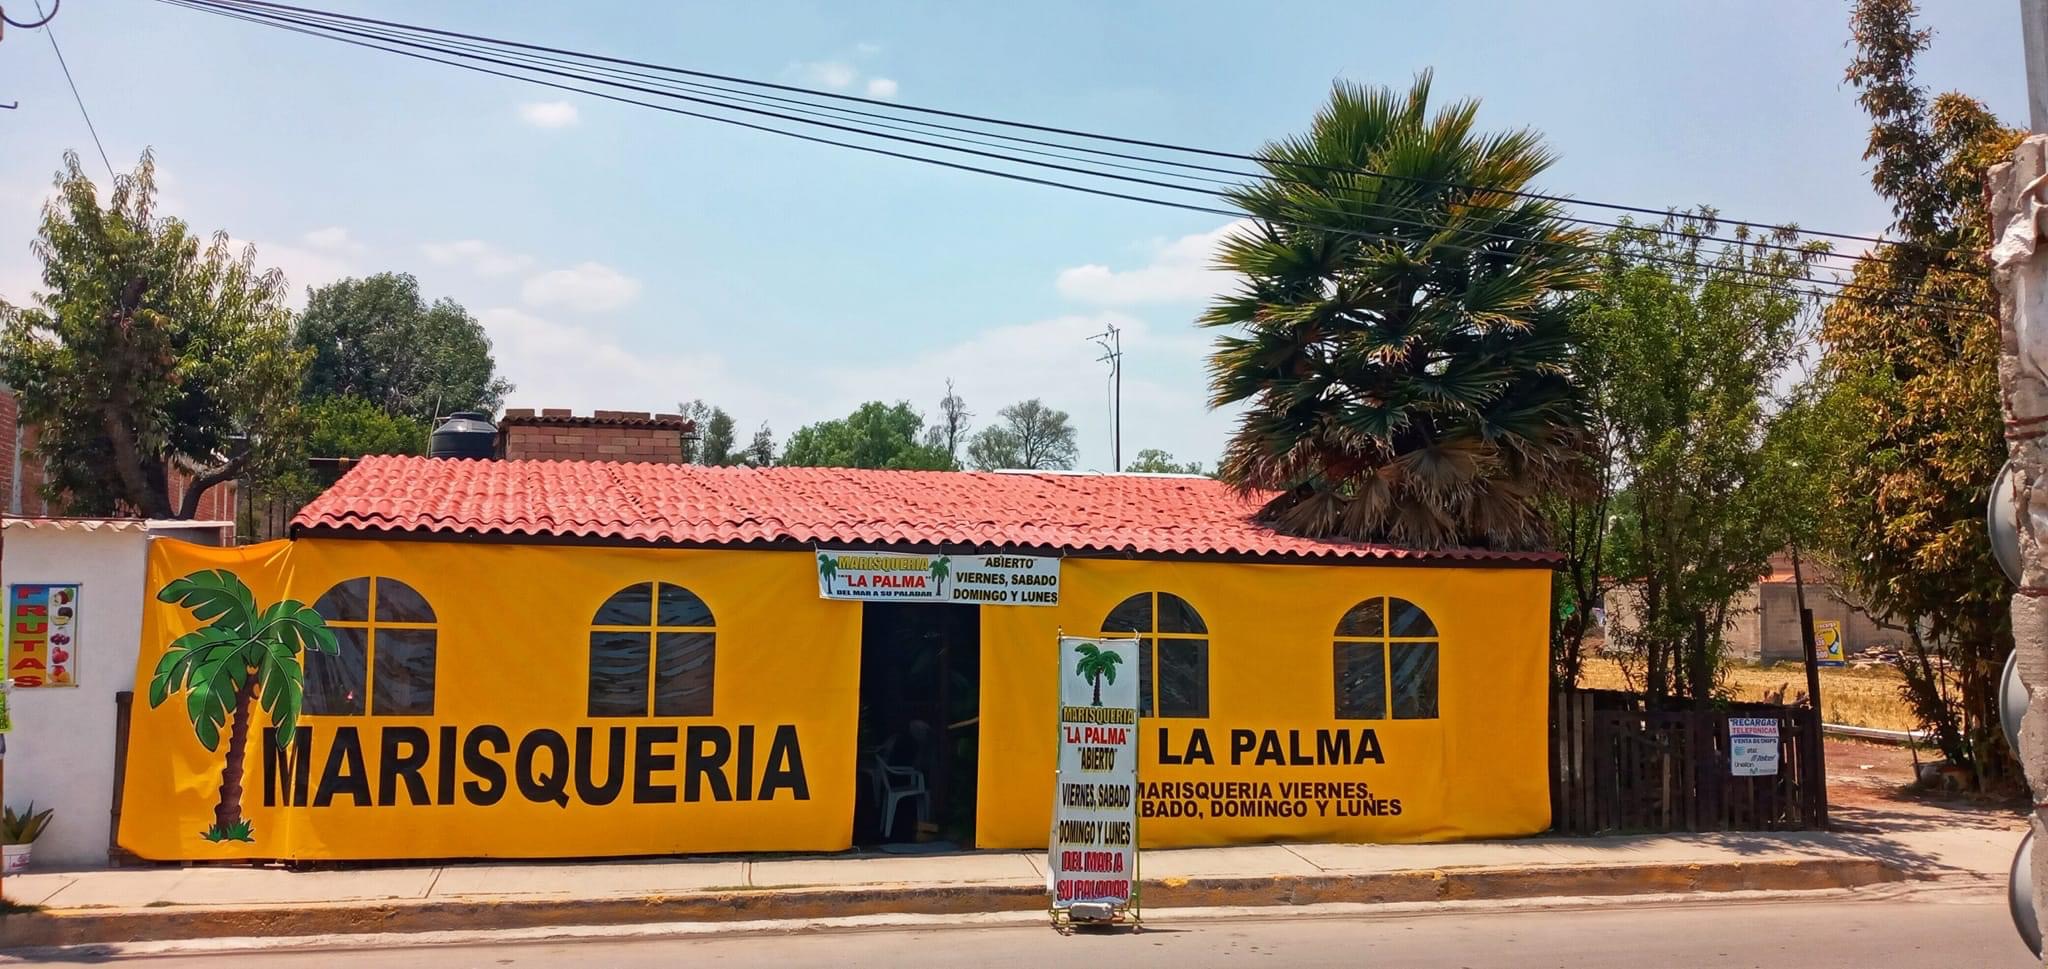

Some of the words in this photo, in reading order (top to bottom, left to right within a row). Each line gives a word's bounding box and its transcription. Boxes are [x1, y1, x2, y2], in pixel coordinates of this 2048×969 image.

[838, 556, 929, 572] MARISQUERIA
[956, 572, 1009, 587] VIERNES,
[1011, 574, 1057, 586] SABADO
[953, 588, 1008, 601] DOMINGO
[1011, 590, 1018, 602] Y
[1022, 591, 1058, 603] LUNES
[12, 587, 48, 688] FRUTAS
[1062, 706, 1135, 725] MARISQUERIA
[1158, 728, 1215, 765] LA
[1231, 729, 1386, 766] PALMA
[262, 724, 811, 809] MARISQUERIA
[1062, 783, 1097, 812] VIERNES,
[1098, 784, 1131, 808] SABADO
[1279, 782, 1374, 801] VIERNES,
[1136, 800, 1204, 819] BADO,
[1211, 800, 1308, 818] DOMINGO
[1315, 800, 1327, 817] Y
[1336, 798, 1402, 817] LUNES
[1060, 820, 1096, 844] DOMINGO
[1097, 821, 1103, 844] Y
[1104, 822, 1131, 845] LUNES
[1062, 851, 1083, 872] DEL
[1084, 852, 1113, 873] MAR
[1114, 852, 1123, 873] A
[1057, 880, 1073, 901] SU
[1074, 880, 1128, 900] PALADAR
